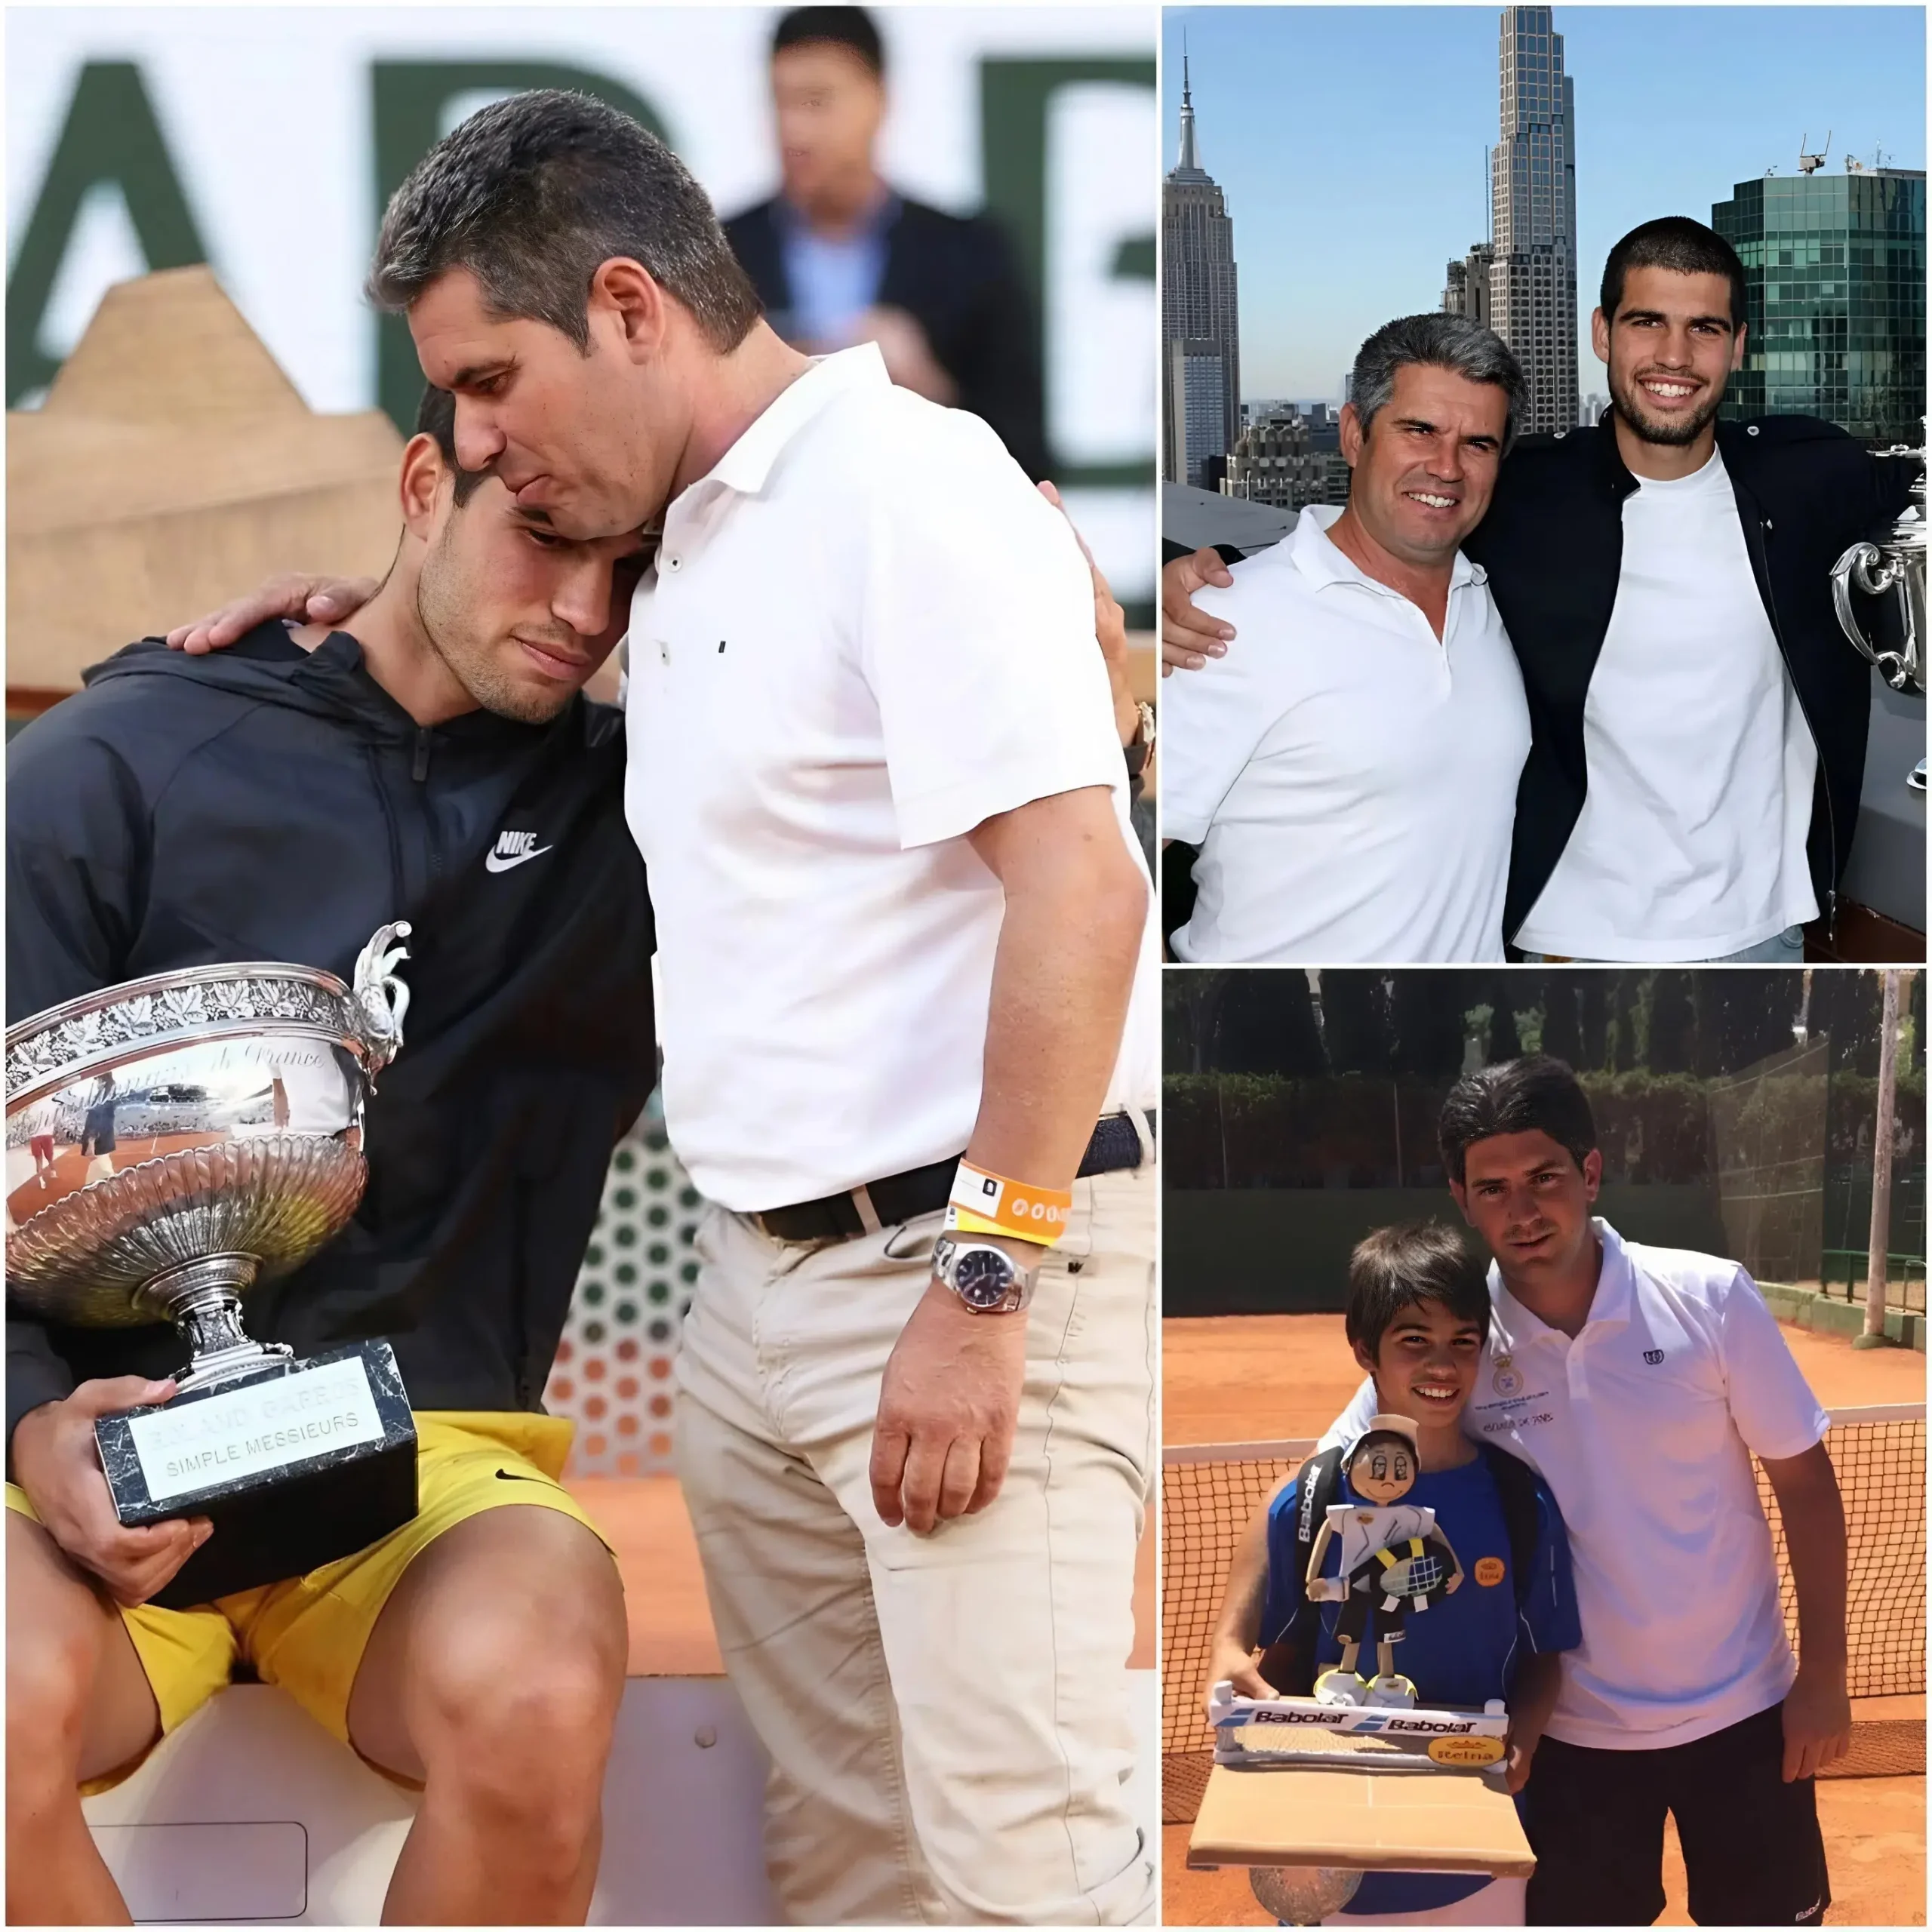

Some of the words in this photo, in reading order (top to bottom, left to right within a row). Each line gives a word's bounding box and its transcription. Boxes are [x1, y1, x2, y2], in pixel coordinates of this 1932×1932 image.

[496, 831, 537, 856] NIKE
[166, 1444, 241, 1477] SIMPLE
[245, 1411, 359, 1457] MESSIEURS
[1254, 1711, 1349, 1725] Babolat
[1387, 1719, 1478, 1734] Babolat
